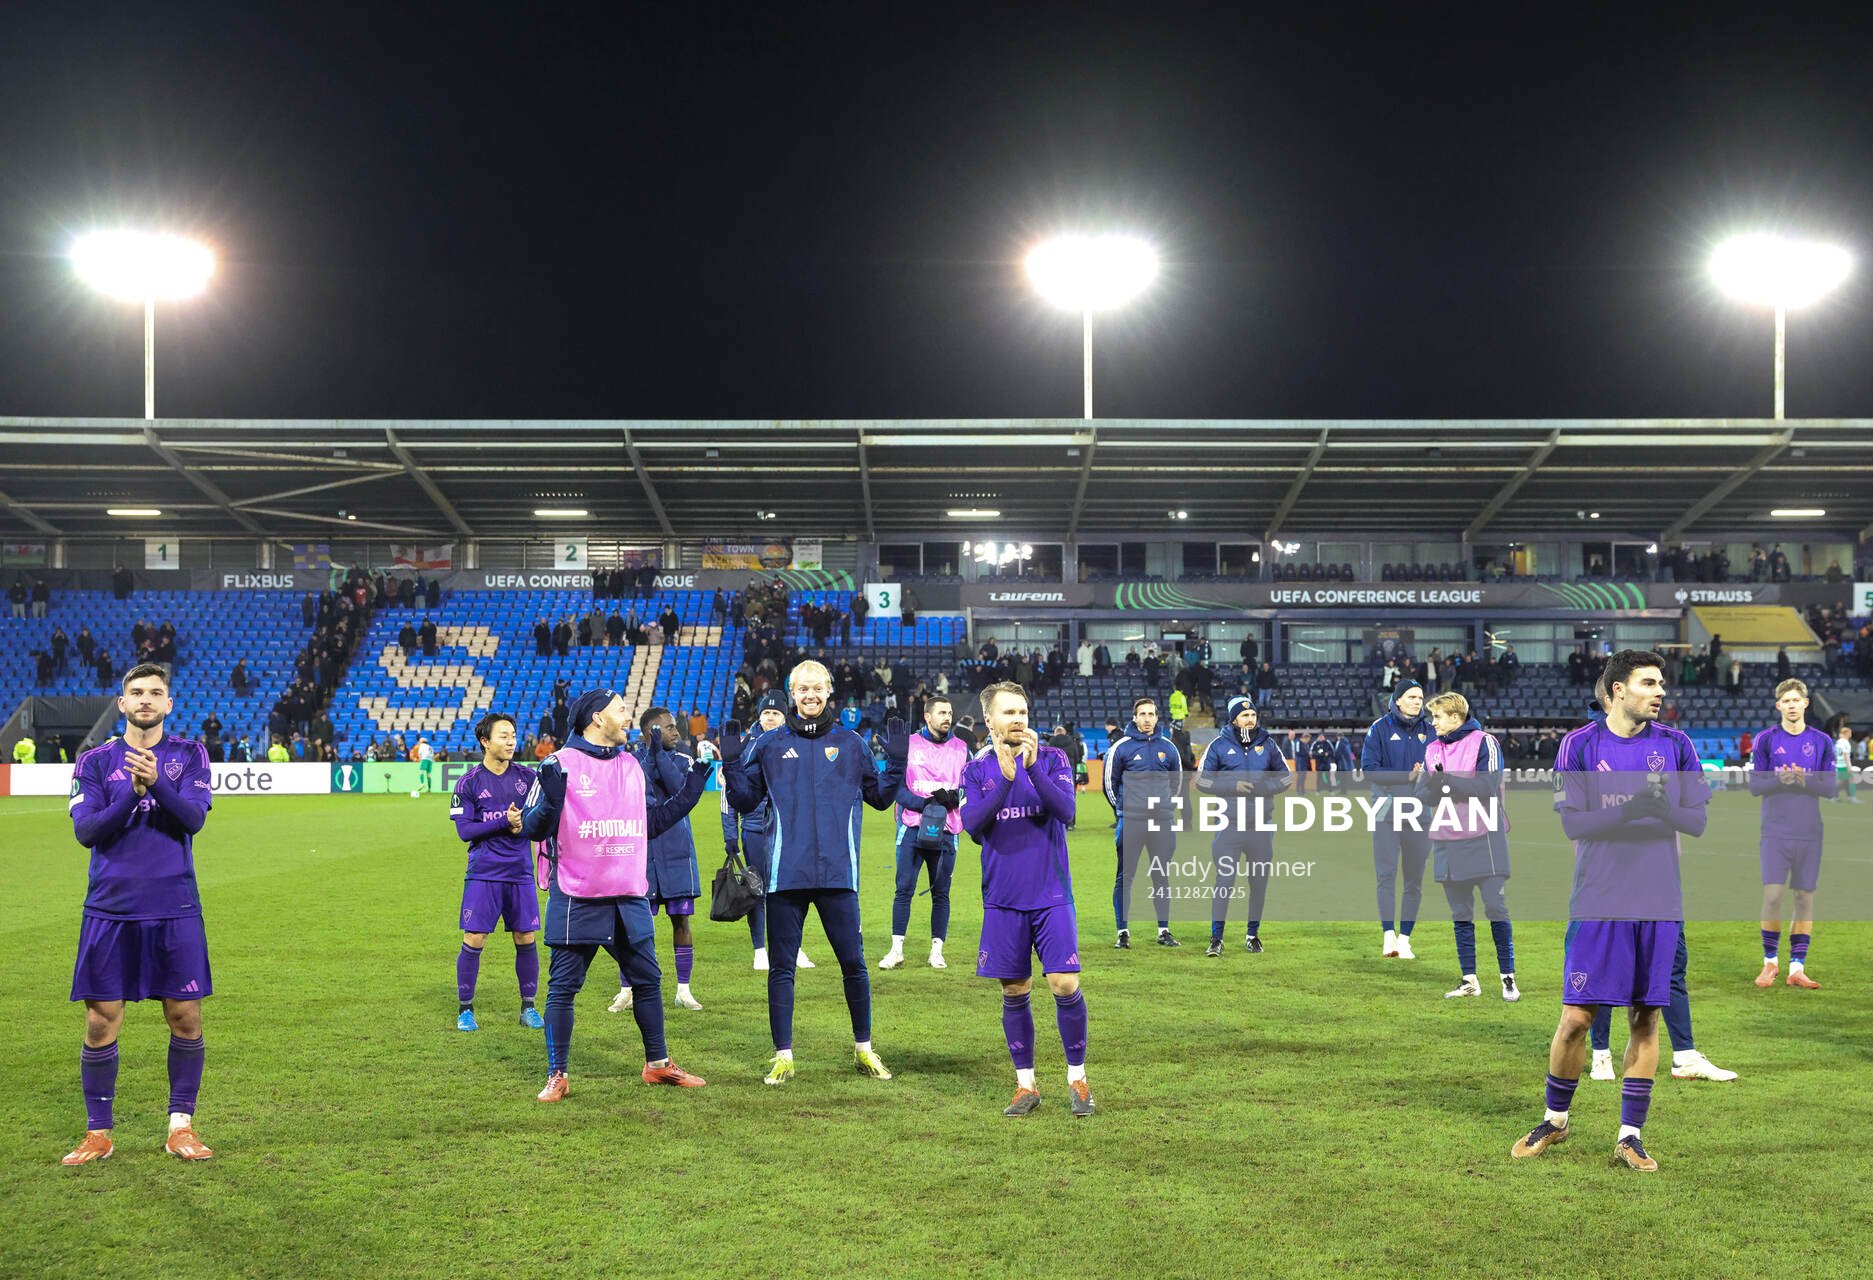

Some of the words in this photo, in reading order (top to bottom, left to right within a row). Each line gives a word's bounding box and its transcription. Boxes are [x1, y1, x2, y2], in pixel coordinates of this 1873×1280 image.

[158, 544, 167, 561] 1
[565, 544, 578, 562] 2
[727, 545, 754, 553] TOWN
[485, 575, 526, 588] UEFA
[529, 575, 597, 588] CONFER
[636, 575, 694, 588] AGUE
[878, 591, 891, 609] 3
[1270, 590, 1311, 603] UEFA
[1315, 590, 1416, 603] CONFERENCE
[1421, 590, 1481, 603] LEAGUE
[1690, 590, 1753, 602] STRAUSS
[1864, 591, 1873, 608] 5
[578, 819, 643, 838] #FOOTBALL
[605, 846, 635, 855] RESPECT
